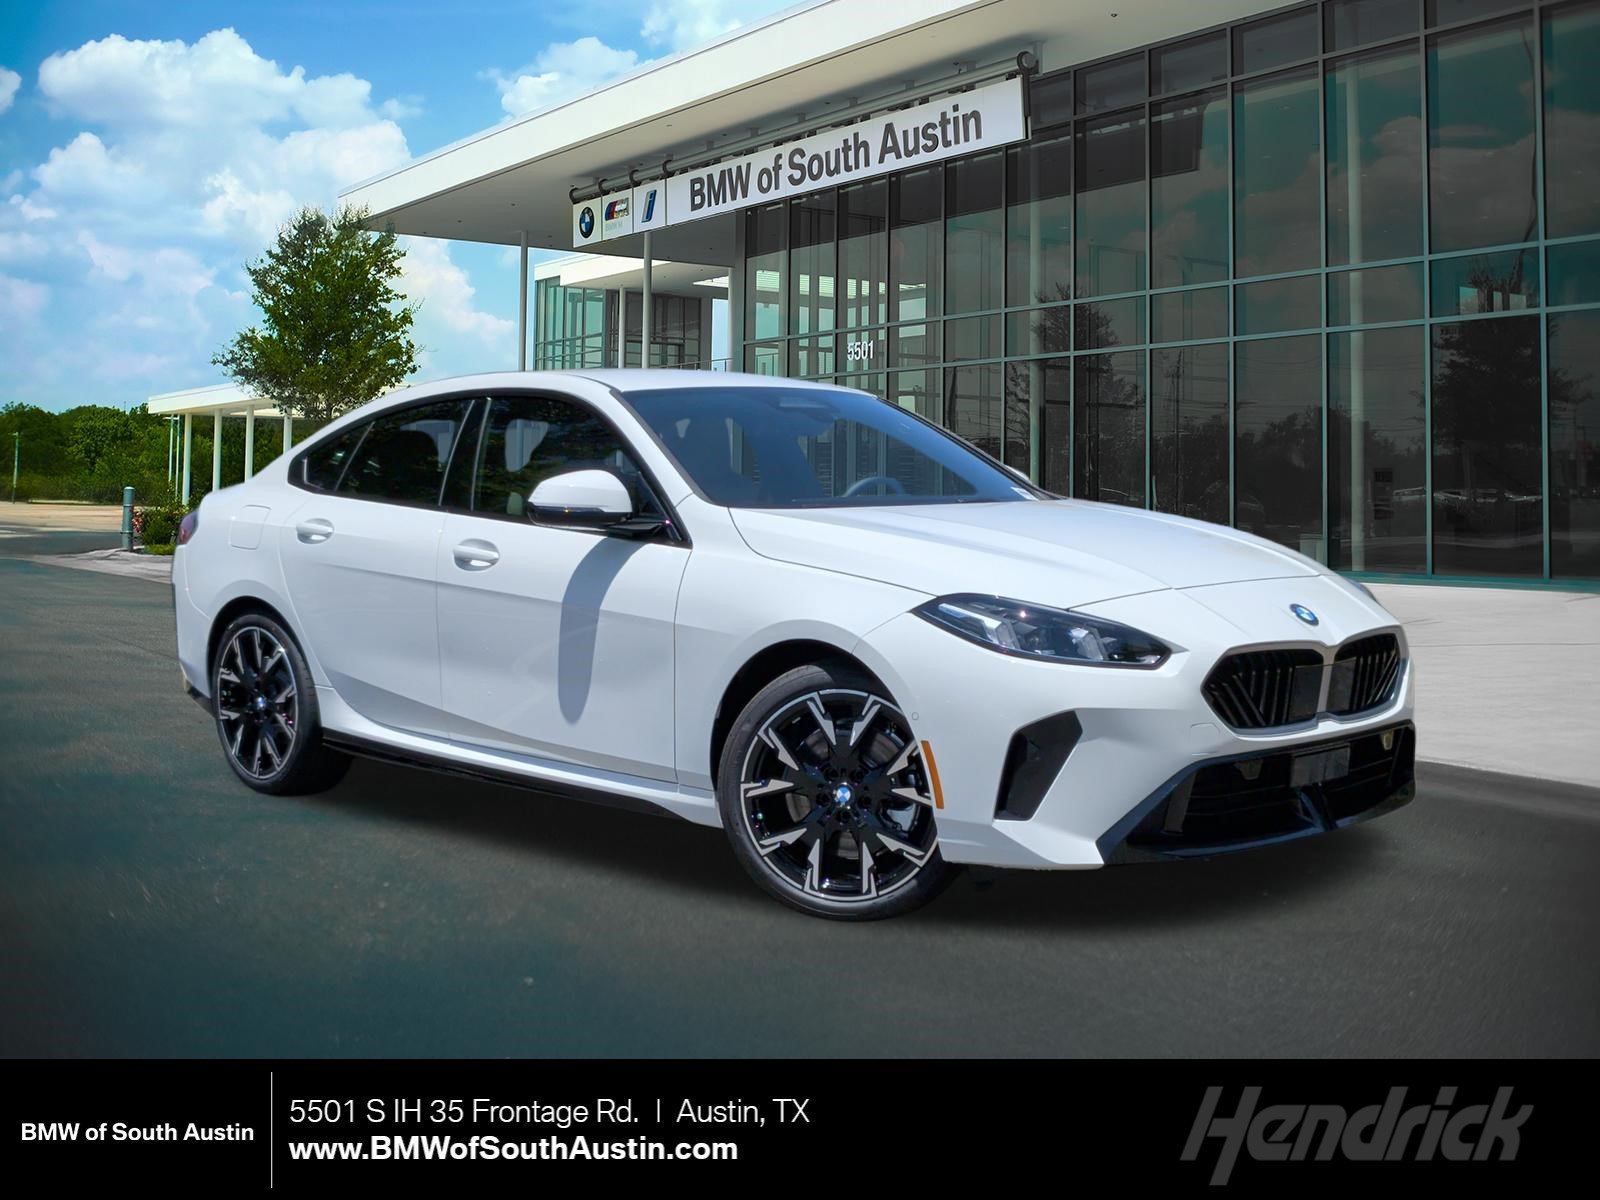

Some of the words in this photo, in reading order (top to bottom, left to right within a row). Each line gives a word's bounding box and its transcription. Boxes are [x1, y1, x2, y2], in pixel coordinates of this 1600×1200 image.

[690, 162, 752, 212] BMW
[757, 153, 783, 194] of
[787, 132, 871, 187] South
[878, 103, 983, 164] Austin
[847, 340, 873, 360] 5501
